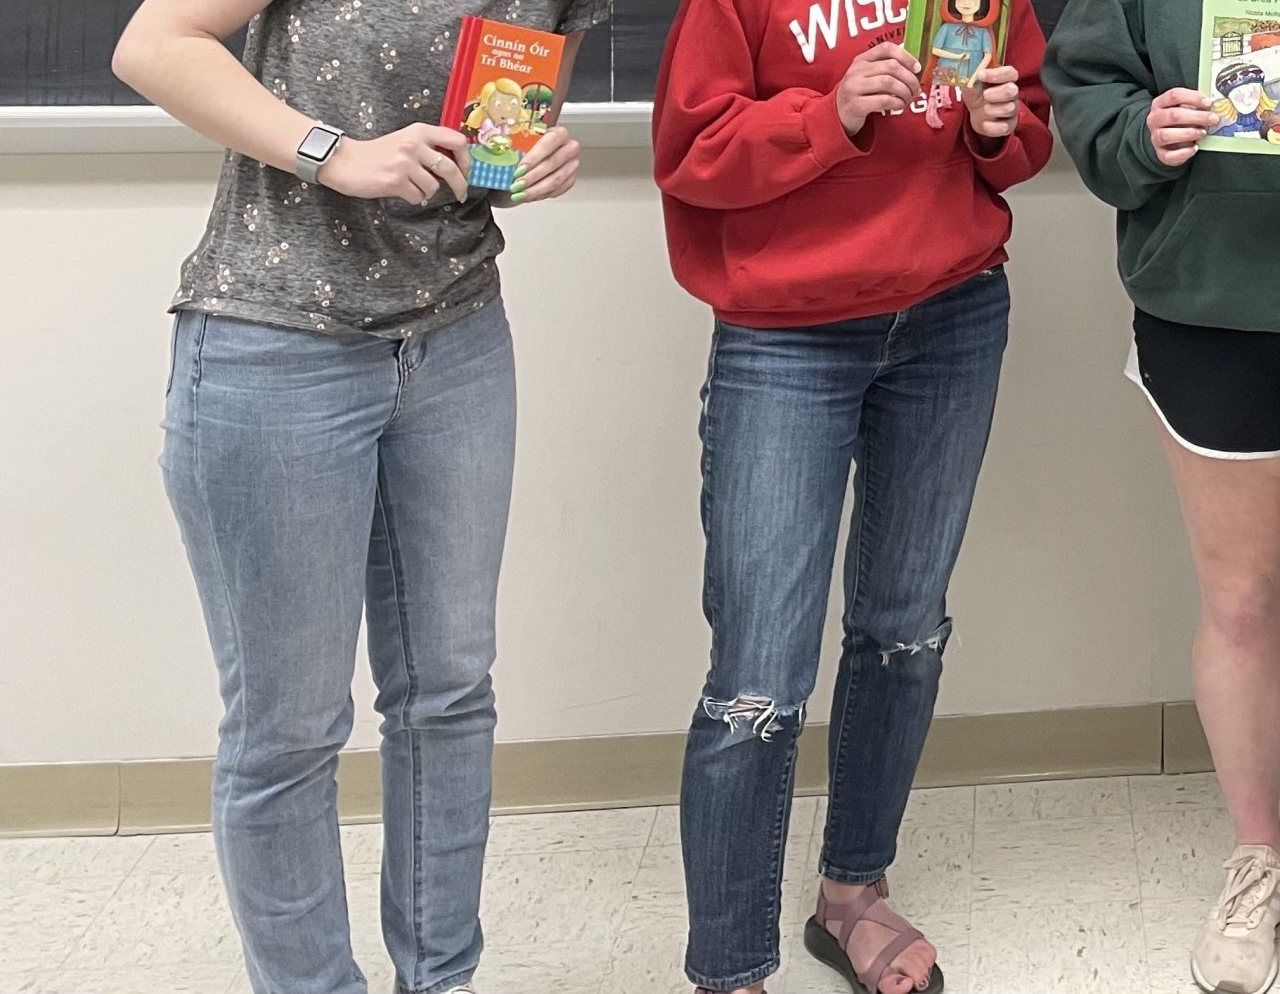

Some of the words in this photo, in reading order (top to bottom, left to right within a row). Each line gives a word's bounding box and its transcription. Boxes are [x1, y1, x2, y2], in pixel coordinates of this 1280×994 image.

[483, 33, 526, 53] Cinnín
[529, 41, 550, 58] Óir
[481, 53, 498, 67] Trí
[500, 56, 533, 74] Bhéar
